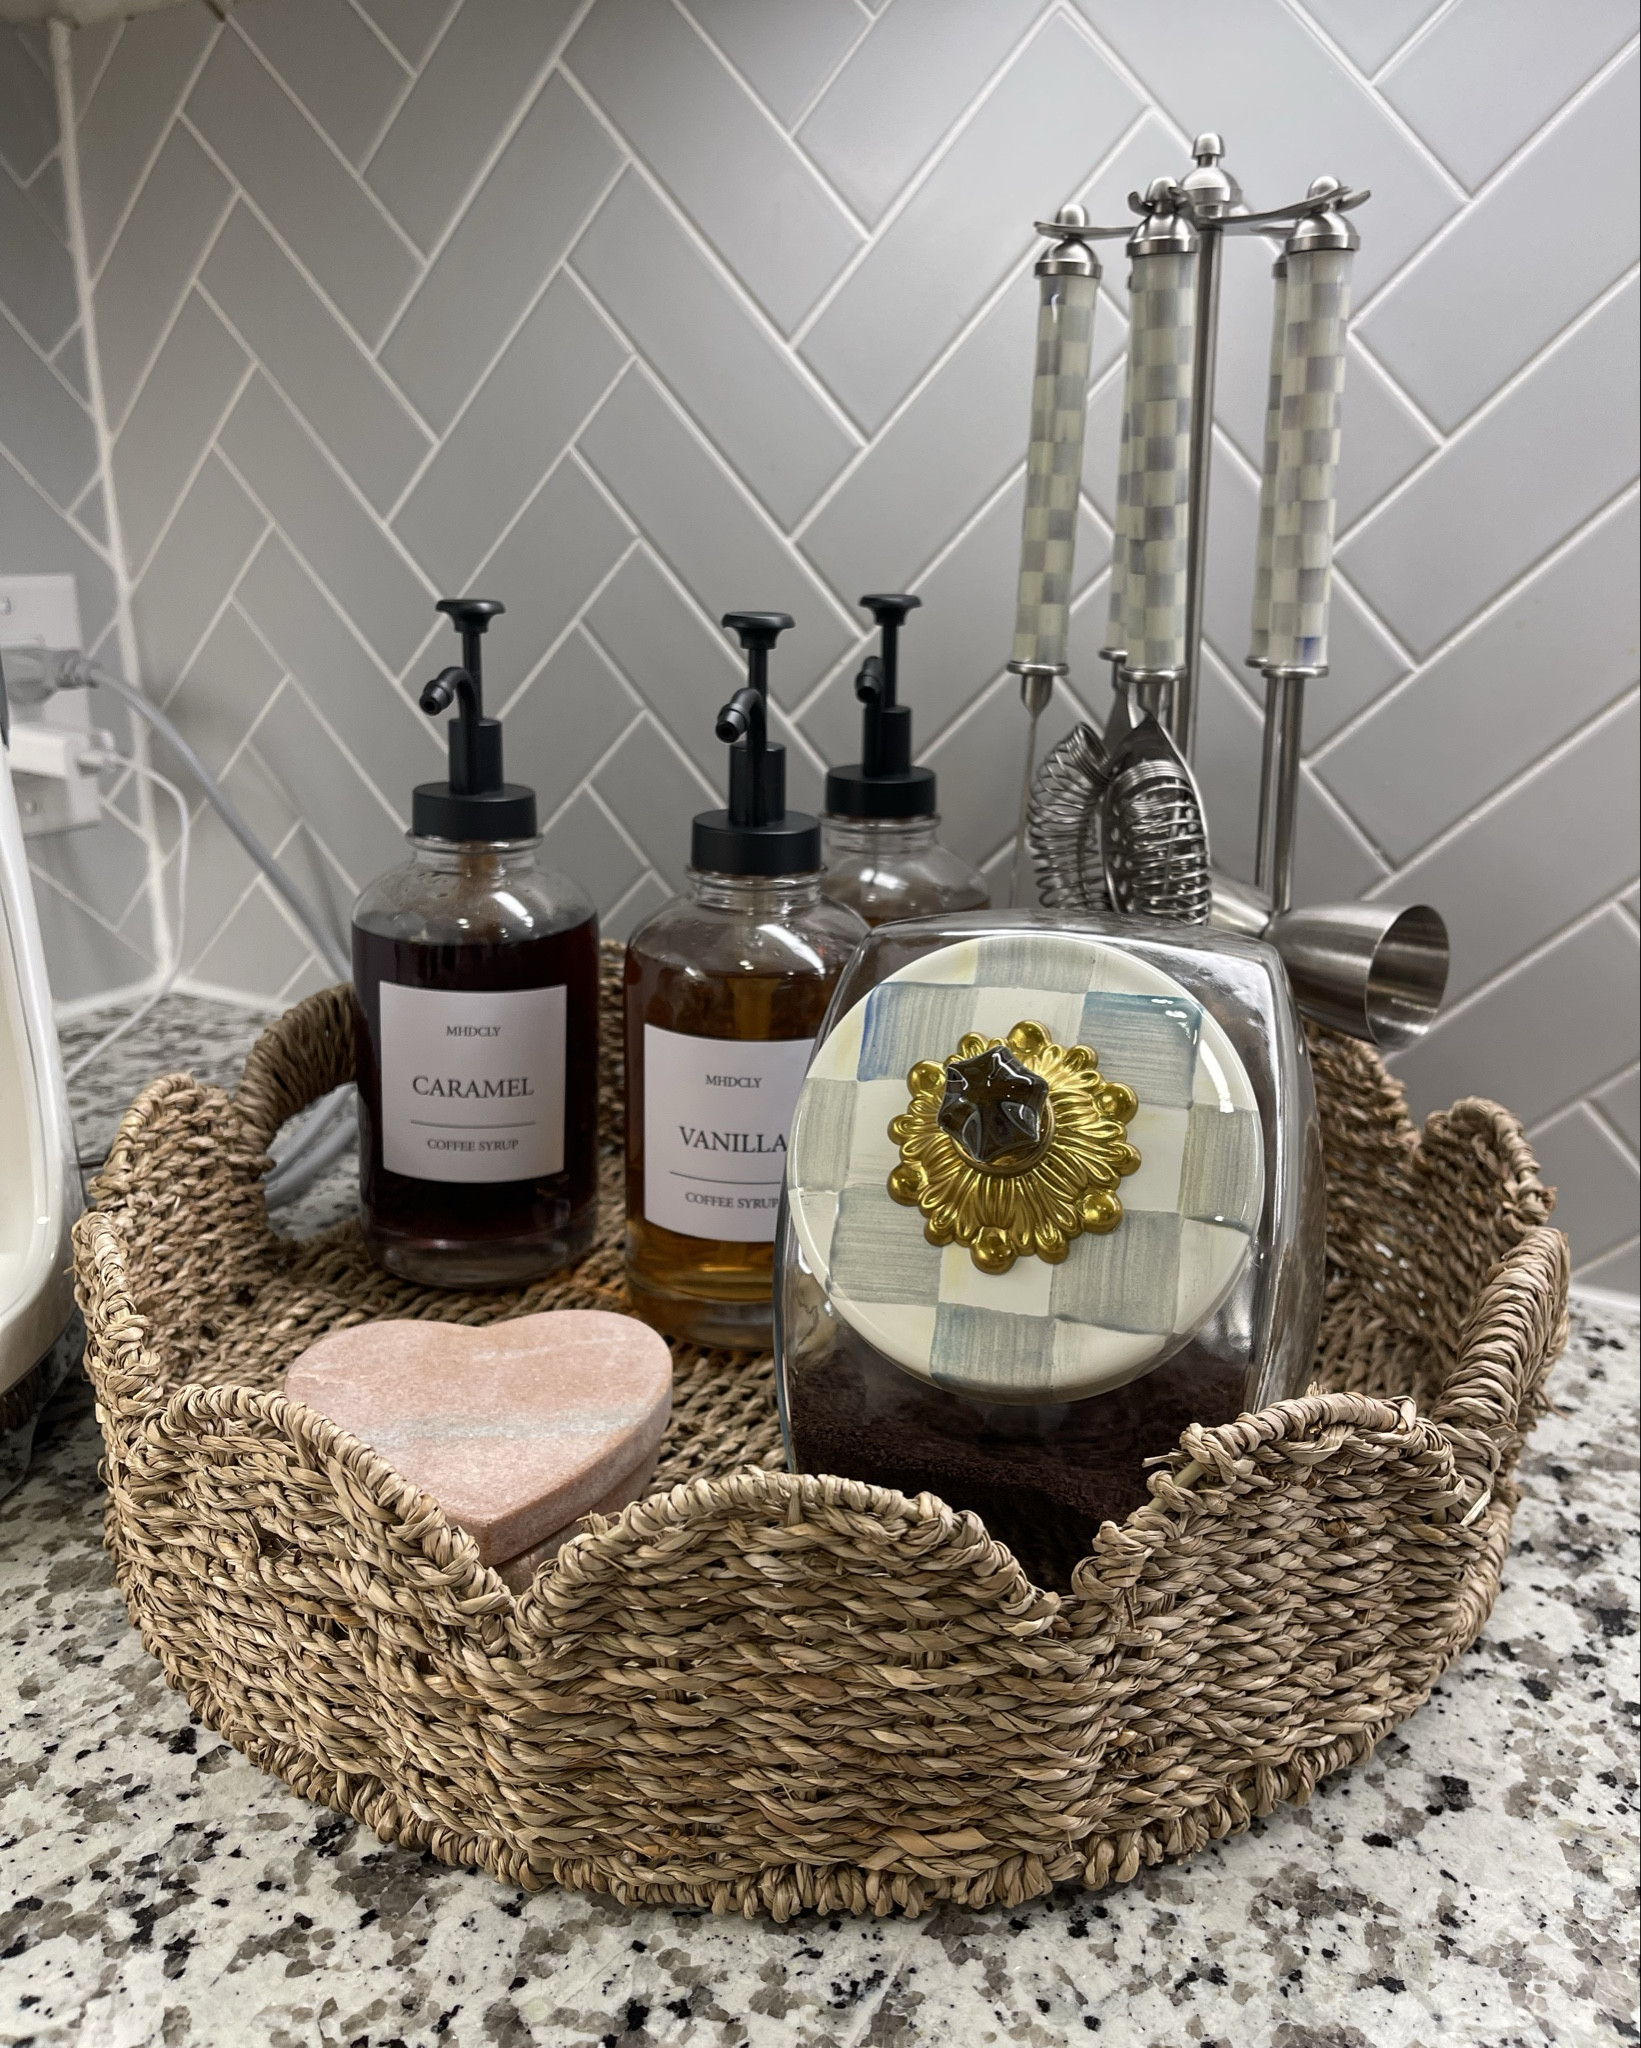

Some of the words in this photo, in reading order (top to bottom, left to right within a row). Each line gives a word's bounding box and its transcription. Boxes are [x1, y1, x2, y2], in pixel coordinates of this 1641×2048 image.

[446, 1026, 501, 1037] MHDCLY
[412, 1075, 535, 1099] CARAMEL
[705, 1074, 762, 1088] MHDCLY
[427, 1139, 475, 1151] COFFEE
[479, 1140, 519, 1151] SYRUP
[678, 1126, 788, 1153] VANILLA
[685, 1192, 734, 1208] COFFEE
[737, 1198, 779, 1209] SYRUP
